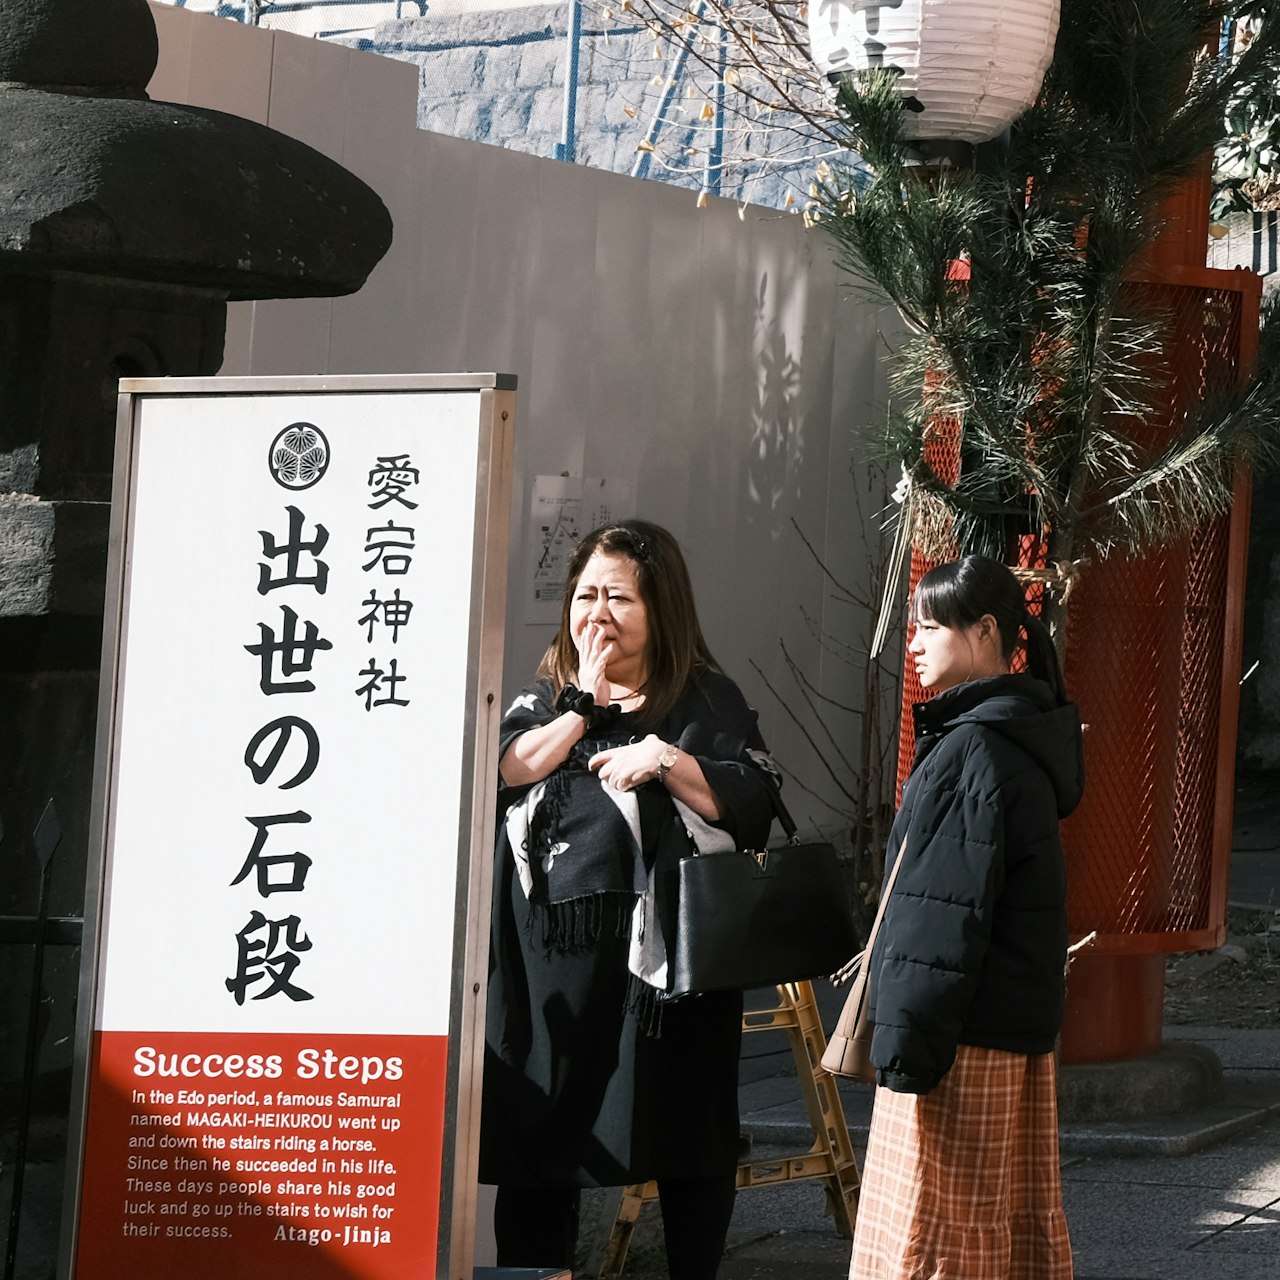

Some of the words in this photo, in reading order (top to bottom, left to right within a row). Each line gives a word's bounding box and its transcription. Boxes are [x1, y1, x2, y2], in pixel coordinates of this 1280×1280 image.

[355, 453, 421, 712] 愛宕神社
[224, 504, 334, 1006] 出世の石段
[134, 1047, 282, 1078] Success
[297, 1049, 403, 1084] Steps
[133, 1090, 145, 1103] In
[150, 1090, 174, 1104] the
[177, 1090, 205, 1104] Edo
[208, 1091, 259, 1107] period,
[263, 1094, 272, 1105] a
[277, 1091, 333, 1106] famous
[337, 1092, 400, 1107] Samurai
[131, 1112, 181, 1126] named
[187, 1112, 332, 1128] MAGAKI-HEIKUROU
[338, 1116, 376, 1129] went
[382, 1119, 400, 1132] up
[129, 1134, 155, 1147] and
[160, 1135, 197, 1148] down
[202, 1135, 225, 1149] the
[230, 1135, 270, 1149] stairs
[274, 1136, 316, 1153] riding
[320, 1140, 329, 1150] a
[332, 1137, 376, 1151] horse.
[128, 1156, 168, 1170] Since
[174, 1156, 207, 1170] then
[213, 1157, 230, 1171] he
[236, 1158, 317, 1172] succeeded
[322, 1159, 335, 1173] in
[341, 1159, 363, 1173] his
[368, 1160, 396, 1174] life.
[126, 1178, 171, 1192] These
[178, 1179, 213, 1194] days
[219, 1180, 271, 1195] people
[277, 1181, 322, 1195] share
[328, 1181, 351, 1195] his
[356, 1183, 395, 1198] good
[125, 1200, 155, 1214] luck
[160, 1201, 187, 1214] and
[192, 1204, 210, 1217] go
[215, 1205, 233, 1217] up
[238, 1202, 262, 1216] the
[267, 1202, 309, 1217] stairs
[314, 1204, 330, 1217] to
[333, 1204, 367, 1218] wish
[372, 1204, 394, 1218] for
[123, 1222, 160, 1236] their
[166, 1226, 232, 1237] success.
[274, 1225, 390, 1247] Atago-Jinja
